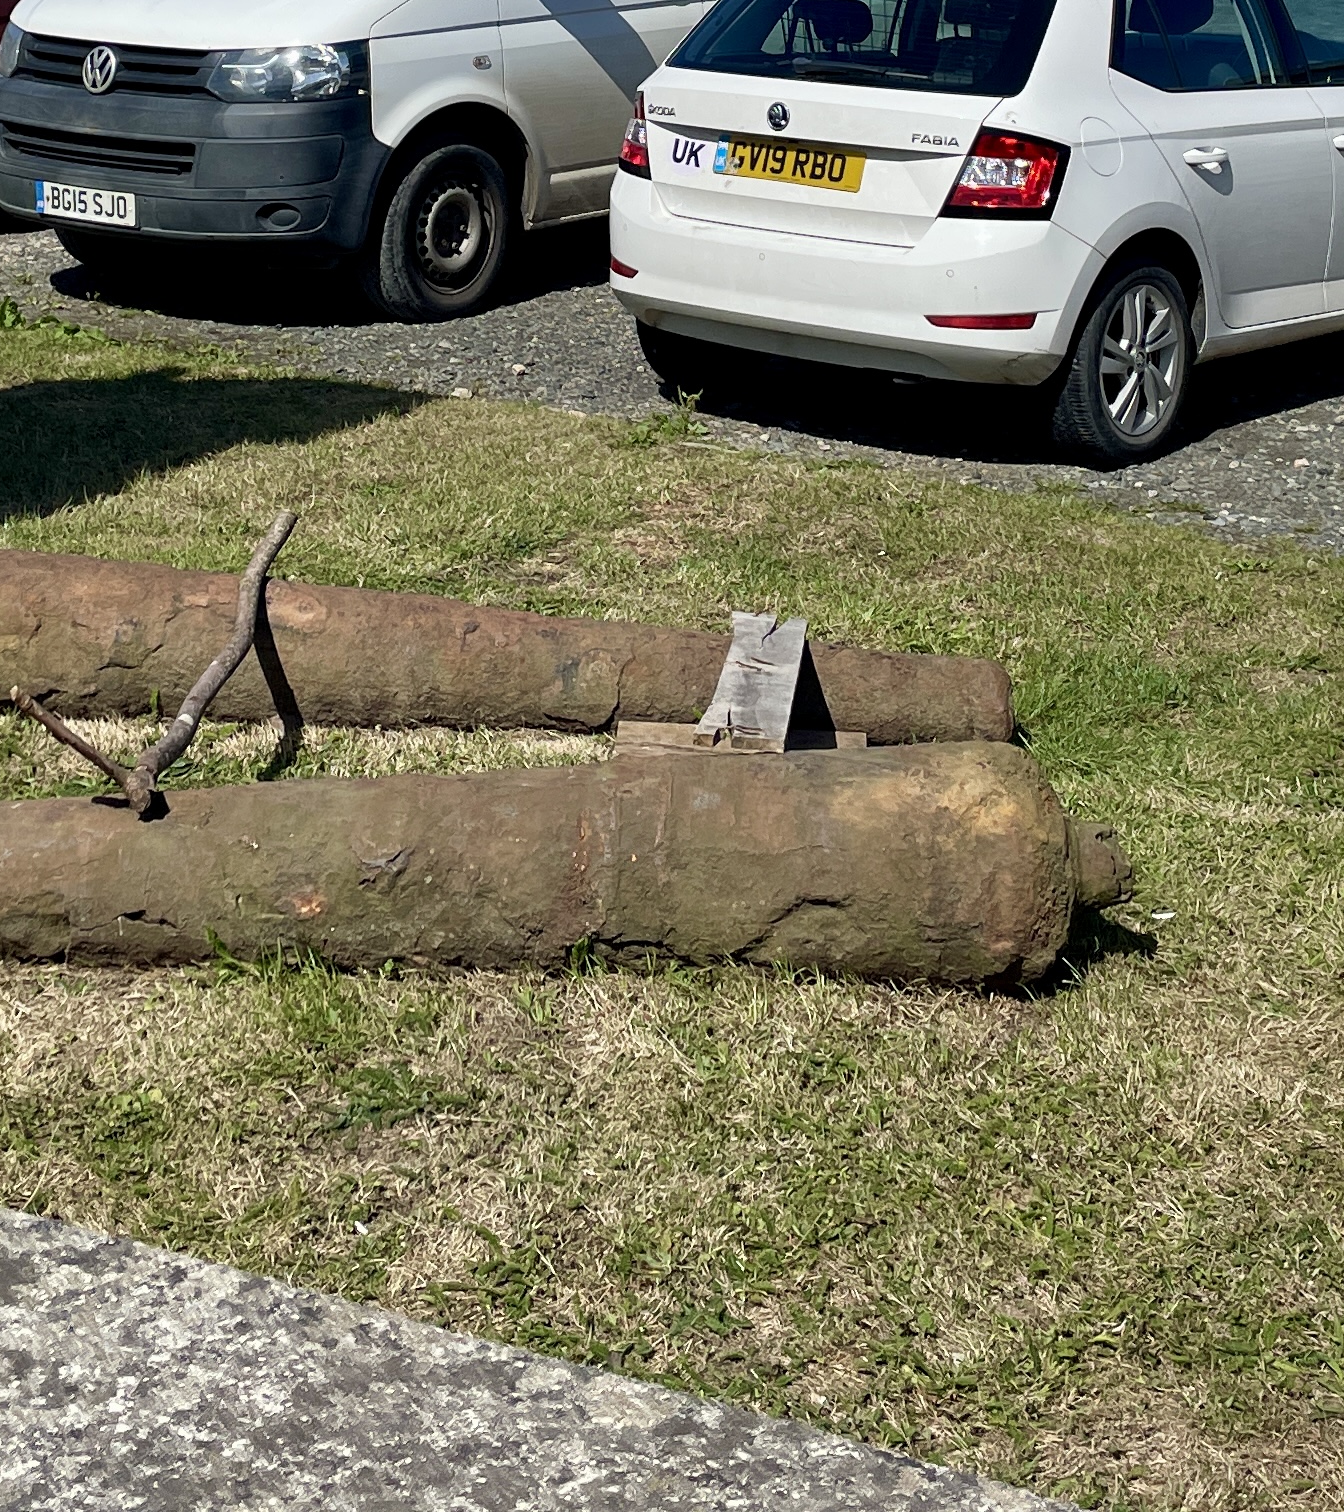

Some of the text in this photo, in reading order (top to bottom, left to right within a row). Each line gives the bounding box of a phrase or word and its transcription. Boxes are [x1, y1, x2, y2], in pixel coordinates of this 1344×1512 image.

[672, 138, 706, 168] UK
[911, 133, 960, 148] FABIA
[730, 141, 847, 183] GV19 RBO
[50, 185, 127, 219] BG15 SJO
